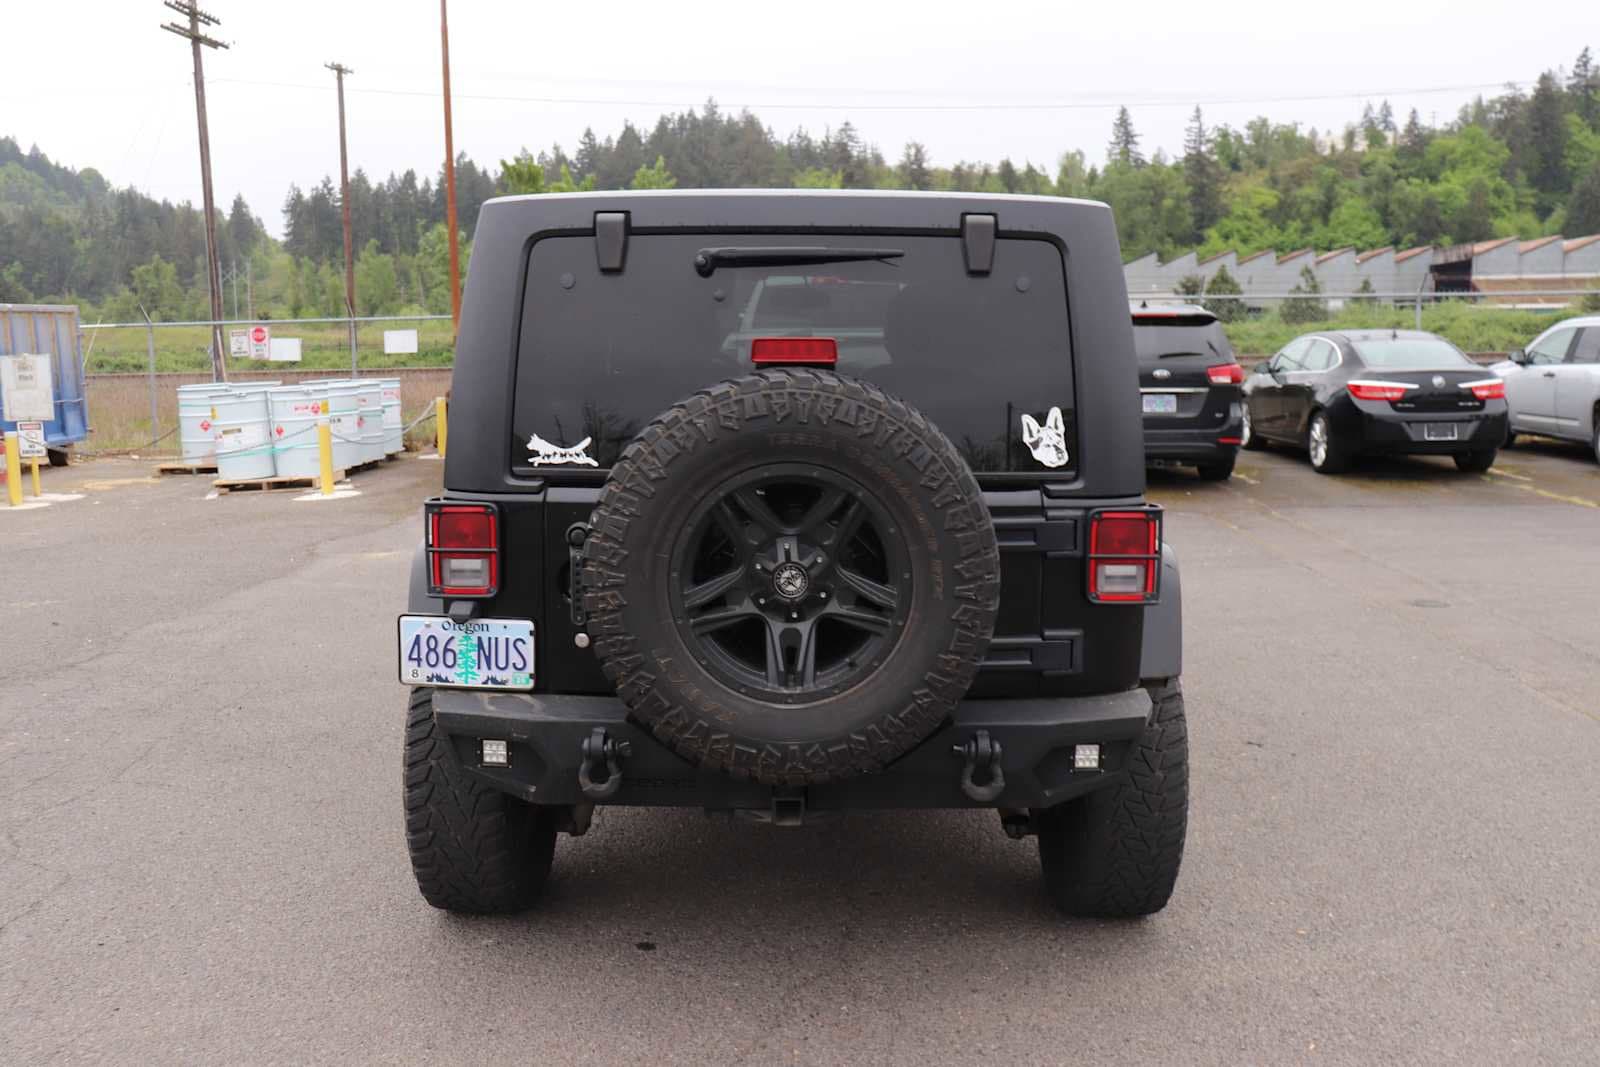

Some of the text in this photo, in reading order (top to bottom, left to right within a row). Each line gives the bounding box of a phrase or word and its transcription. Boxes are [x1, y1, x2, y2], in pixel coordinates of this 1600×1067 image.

[441, 620, 490, 634] Oregon
[408, 634, 527, 671] 486 NUS
[411, 669, 419, 678] 8
